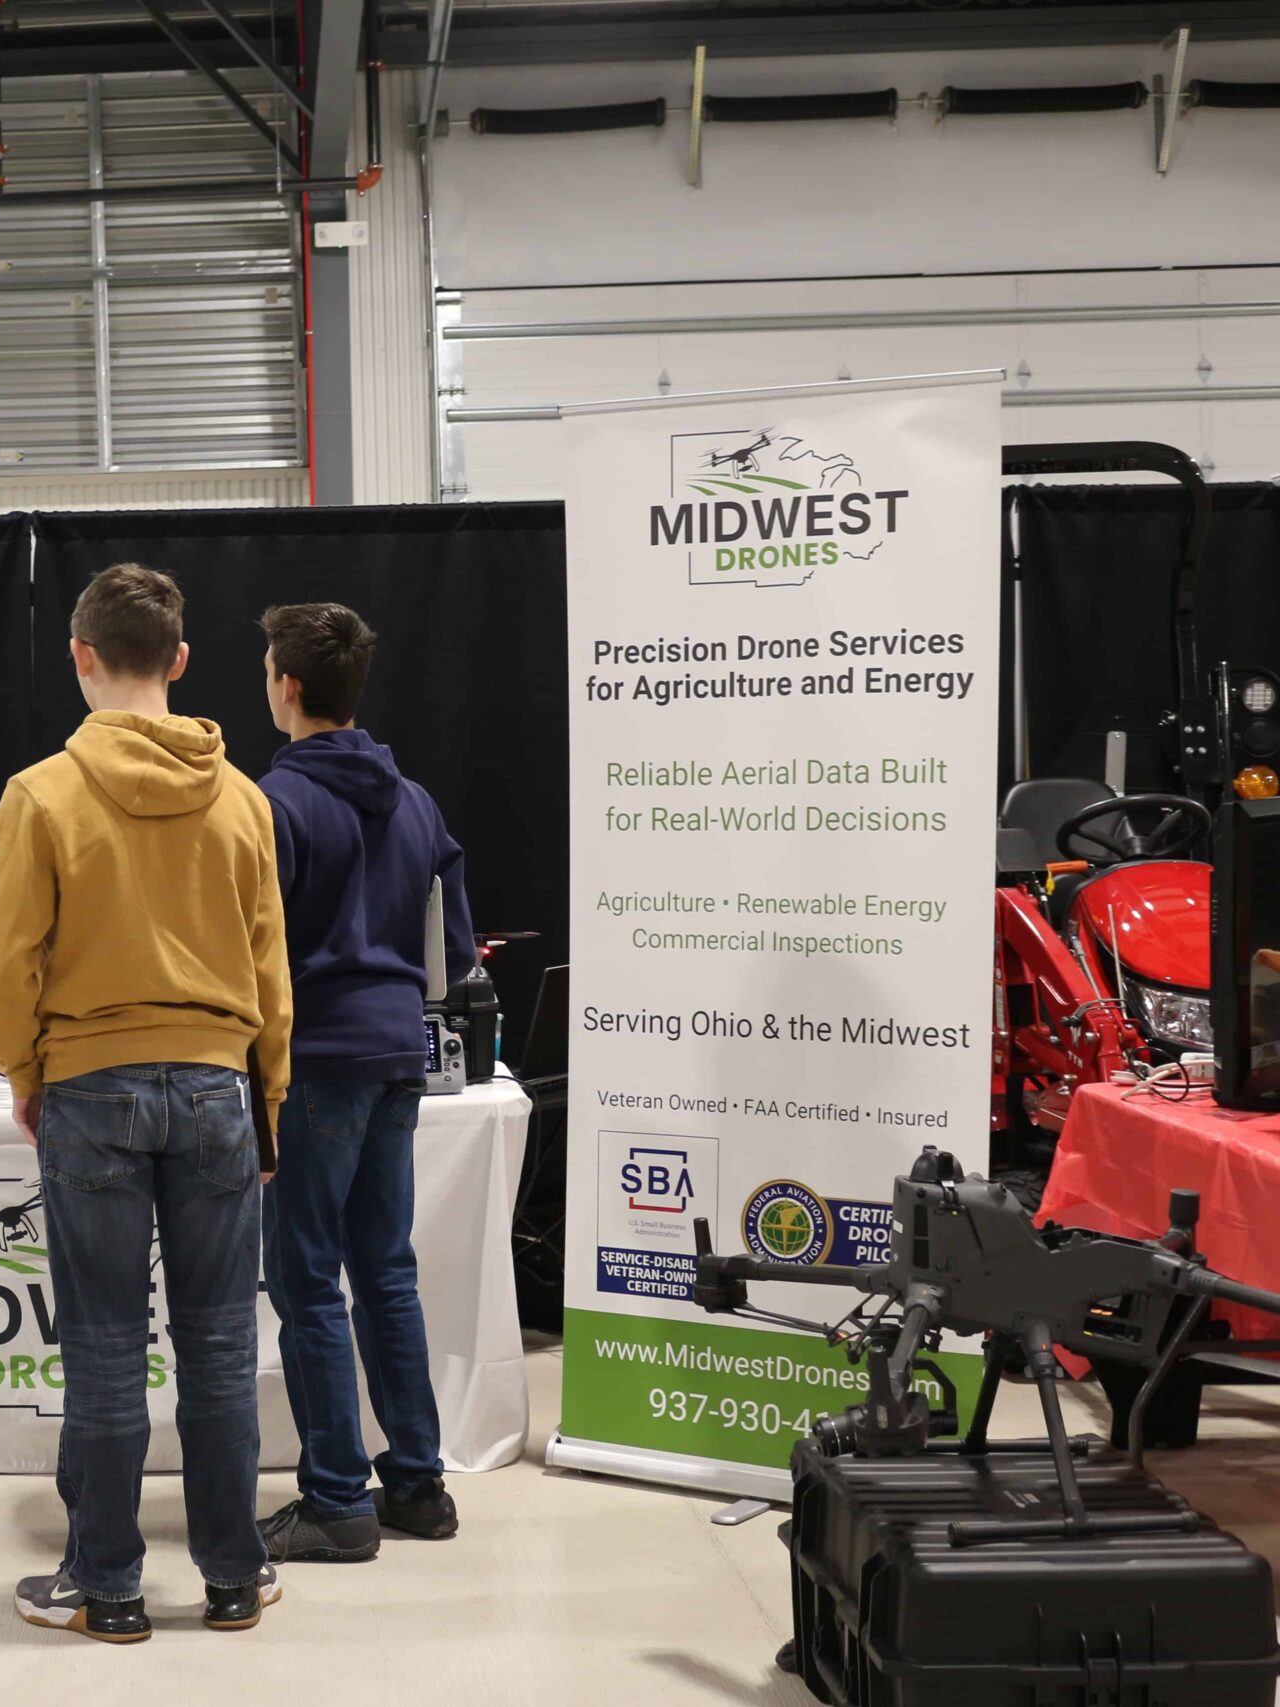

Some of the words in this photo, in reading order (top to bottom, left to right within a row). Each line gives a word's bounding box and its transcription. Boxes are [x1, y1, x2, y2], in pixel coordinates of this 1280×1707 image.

[650, 490, 909, 546] MIDWEST
[716, 541, 839, 571] DRONES
[594, 636, 727, 664] Precision
[737, 633, 820, 661] Drone
[829, 628, 964, 658] Services
[586, 675, 625, 701] for
[632, 671, 792, 706] Agriculture
[800, 667, 854, 695] and
[865, 667, 974, 699] Energy
[607, 761, 713, 787] Reliable
[722, 759, 797, 786] Aerial
[807, 758, 870, 785] Data
[881, 757, 947, 784] Built
[606, 806, 642, 831] for
[651, 805, 796, 831] Real-World
[806, 805, 947, 831] Decisions
[596, 891, 715, 917] Agriculture
[737, 893, 856, 916] Renewable
[865, 895, 946, 922] Energy
[632, 928, 765, 951] Commercial
[773, 931, 903, 957] Inspections
[583, 1007, 681, 1040] Serving
[691, 1010, 753, 1039] Ohio
[762, 1014, 780, 1039] &
[788, 1014, 832, 1042] the
[842, 1017, 971, 1048] Midwest
[597, 1091, 664, 1110] Veteran
[669, 1094, 728, 1114] Owned
[744, 1099, 780, 1118] FAA
[785, 1101, 860, 1123] Certified
[877, 1108, 949, 1128] Insured
[621, 1163, 694, 1198] SBA
[749, 1187, 782, 1218] FEDERAL
[787, 1187, 823, 1224] AVIATION
[839, 1206, 893, 1225] CERTIF
[848, 1226, 891, 1244] DRO
[601, 1251, 696, 1271] SERVICE-DISABL
[856, 1246, 891, 1263] PILO
[605, 1264, 696, 1284] VETERAN-OWN
[627, 1280, 688, 1297] CERTIFIED
